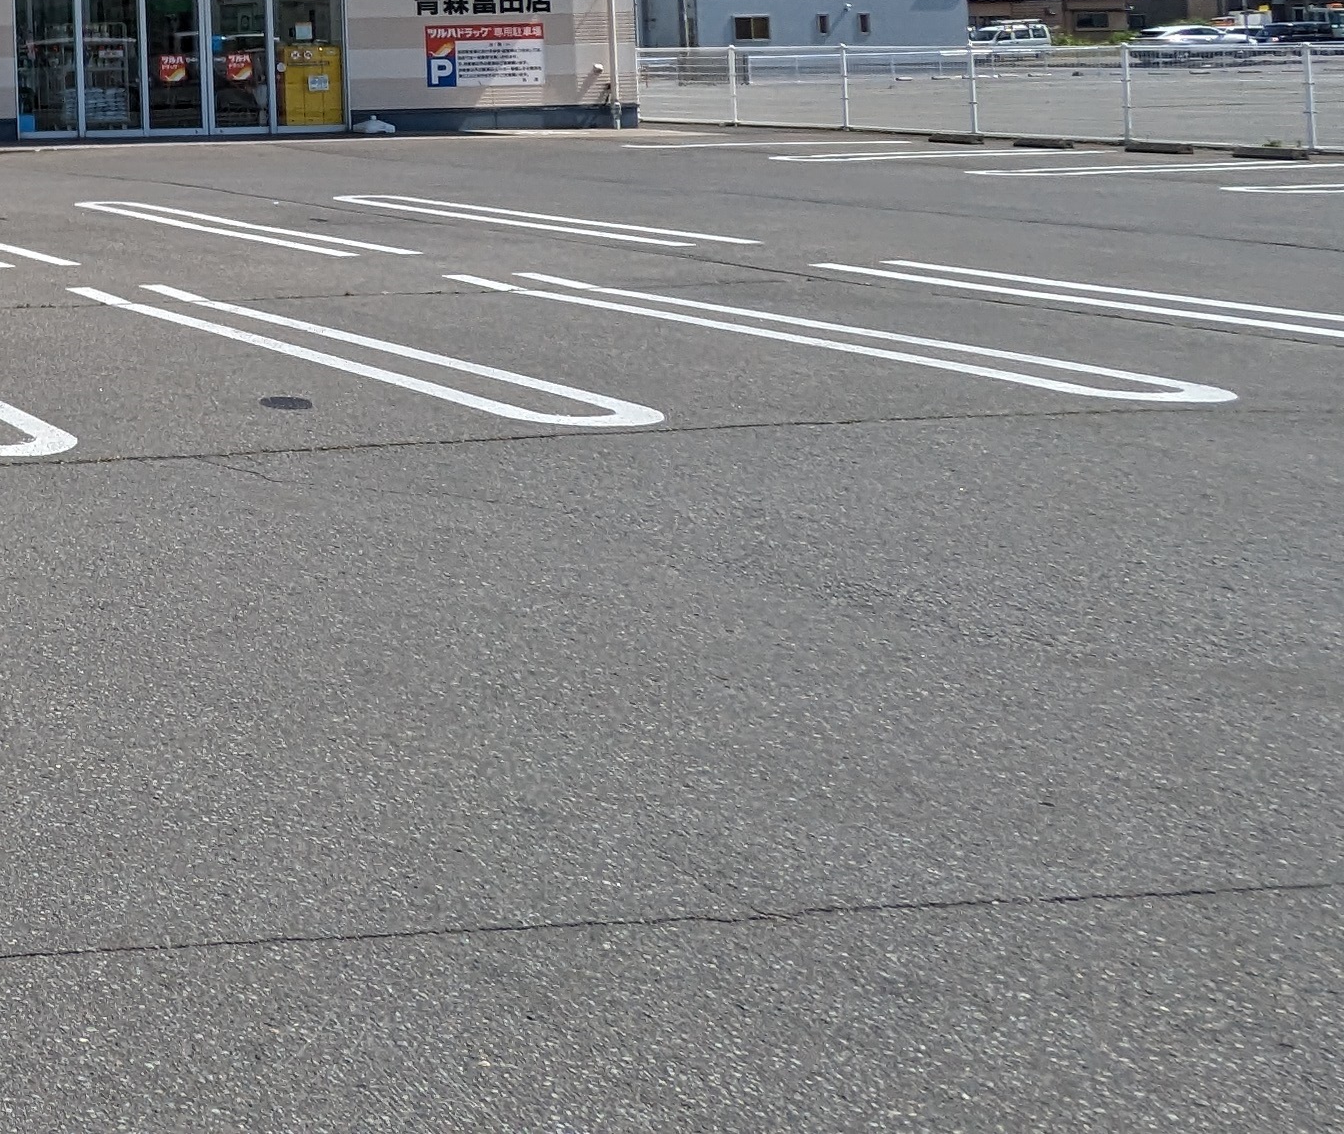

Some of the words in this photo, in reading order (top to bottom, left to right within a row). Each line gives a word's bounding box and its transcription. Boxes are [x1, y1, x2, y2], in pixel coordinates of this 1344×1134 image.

[427, 27, 492, 38] ツルハドラッグ
[494, 26, 543, 37] 専用駐車場
[161, 55, 184, 64] ツルハ
[228, 54, 251, 64] ツルハ
[430, 59, 453, 84] P
